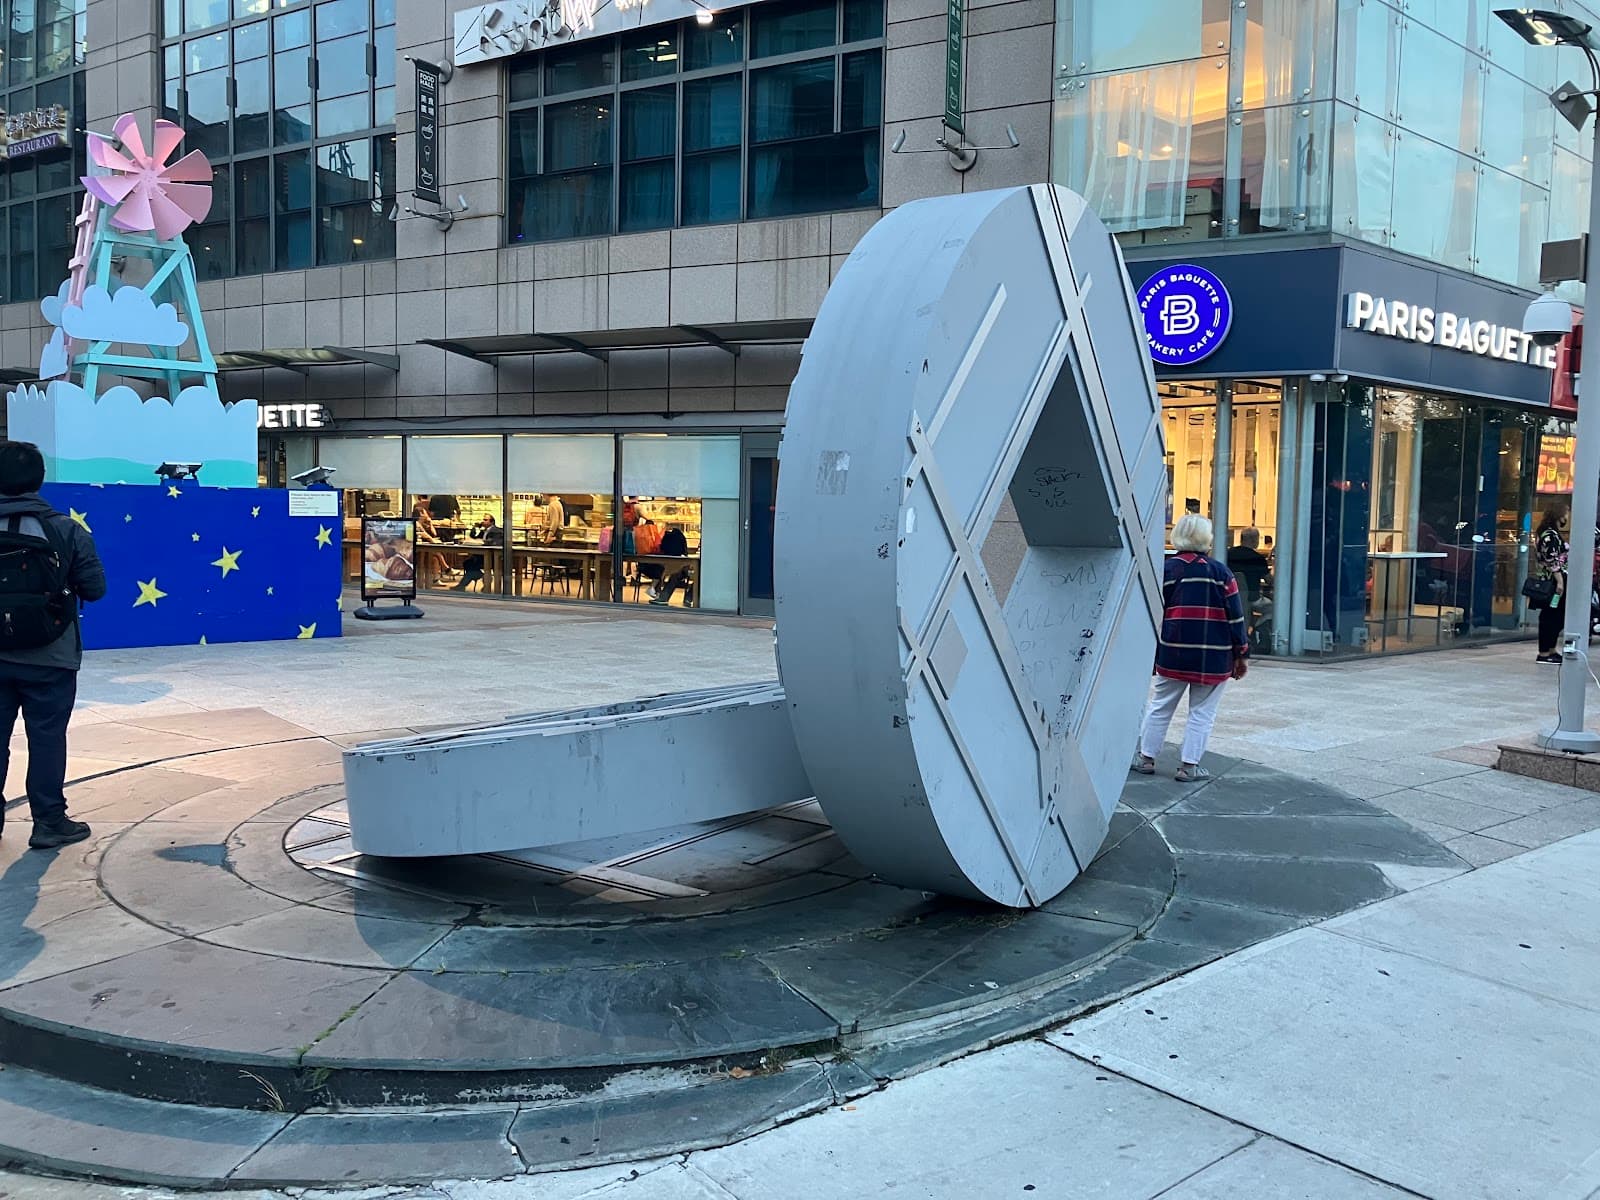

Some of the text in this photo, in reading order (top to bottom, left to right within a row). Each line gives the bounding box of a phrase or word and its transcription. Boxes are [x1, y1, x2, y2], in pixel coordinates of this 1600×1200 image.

[419, 72, 435, 83] FOOD
[9, 135, 56, 156] RESTAURANT
[1141, 273, 1220, 308] PARIS BAGUETTE
[1160, 294, 1200, 335] B
[1347, 292, 1436, 344] PARIS
[1146, 329, 1215, 356] BAKERY CAFÉ
